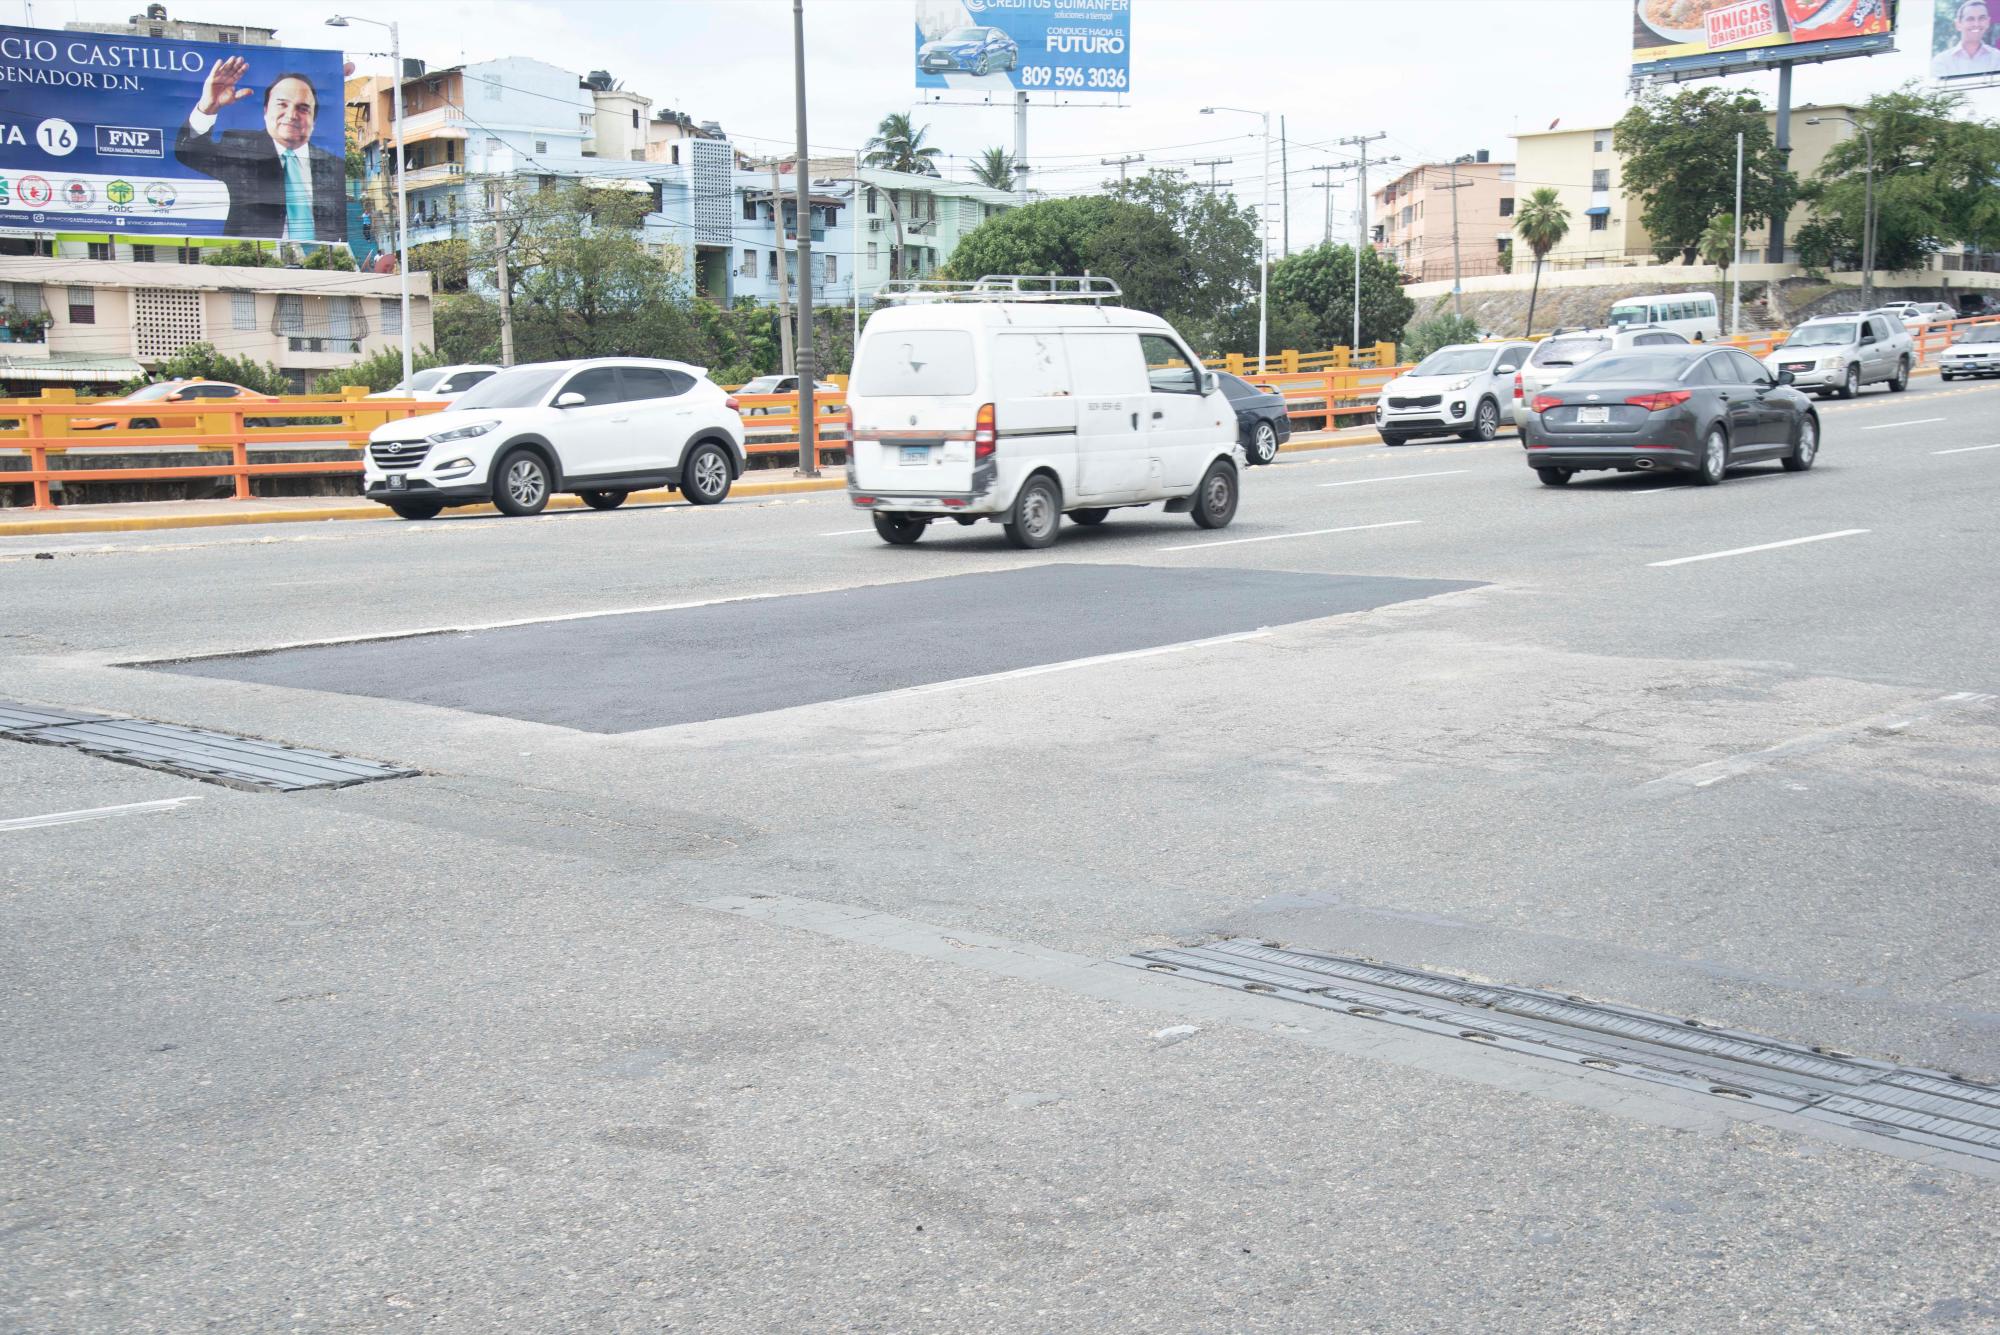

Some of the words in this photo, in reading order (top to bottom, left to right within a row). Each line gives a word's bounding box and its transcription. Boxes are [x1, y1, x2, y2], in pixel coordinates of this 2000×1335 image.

[1054, 0, 1128, 11] GUIMANFER
[1711, 3, 1770, 33] UNICAS
[1047, 27, 1088, 36] CONDUCE
[1089, 28, 1114, 36] HACIA
[1115, 29, 1124, 37] EL
[1711, 20, 1773, 45] ORIGINALES
[1, 37, 57, 62] CIO
[67, 43, 204, 72] CASTILLO
[1046, 36, 1125, 54] FUTURO
[103, 74, 145, 91] D.N.
[1022, 66, 1052, 86] 809
[1055, 66, 1085, 87] 596
[1088, 67, 1127, 88] 3036
[44, 127, 72, 149] 16
[108, 130, 150, 147] FNP
